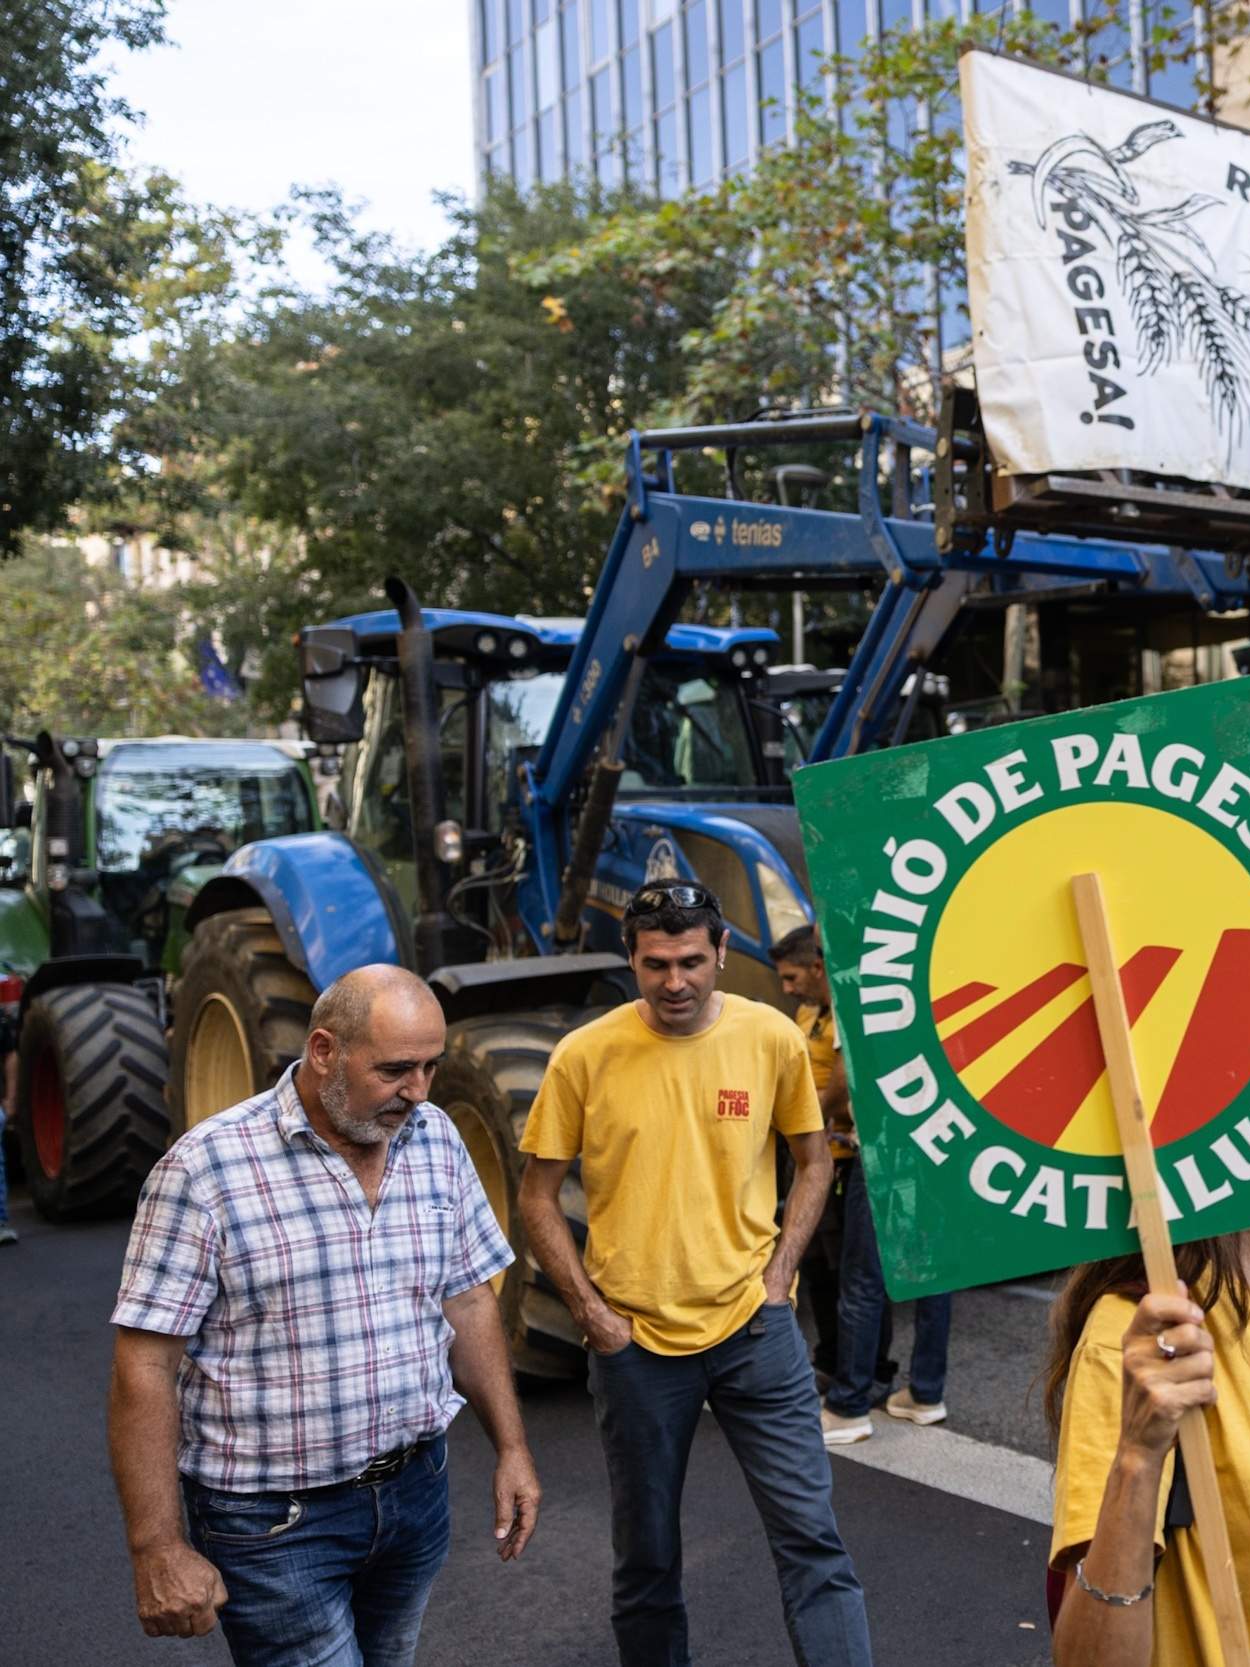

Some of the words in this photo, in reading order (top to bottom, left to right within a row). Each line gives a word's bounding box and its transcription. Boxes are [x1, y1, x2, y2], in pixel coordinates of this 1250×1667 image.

[1050, 199, 1136, 430] PAGESA!
[858, 837, 947, 1036] UNIÓ
[933, 750, 1044, 845] DE
[729, 1101, 750, 1117] FOC
[875, 1054, 977, 1167] DE
